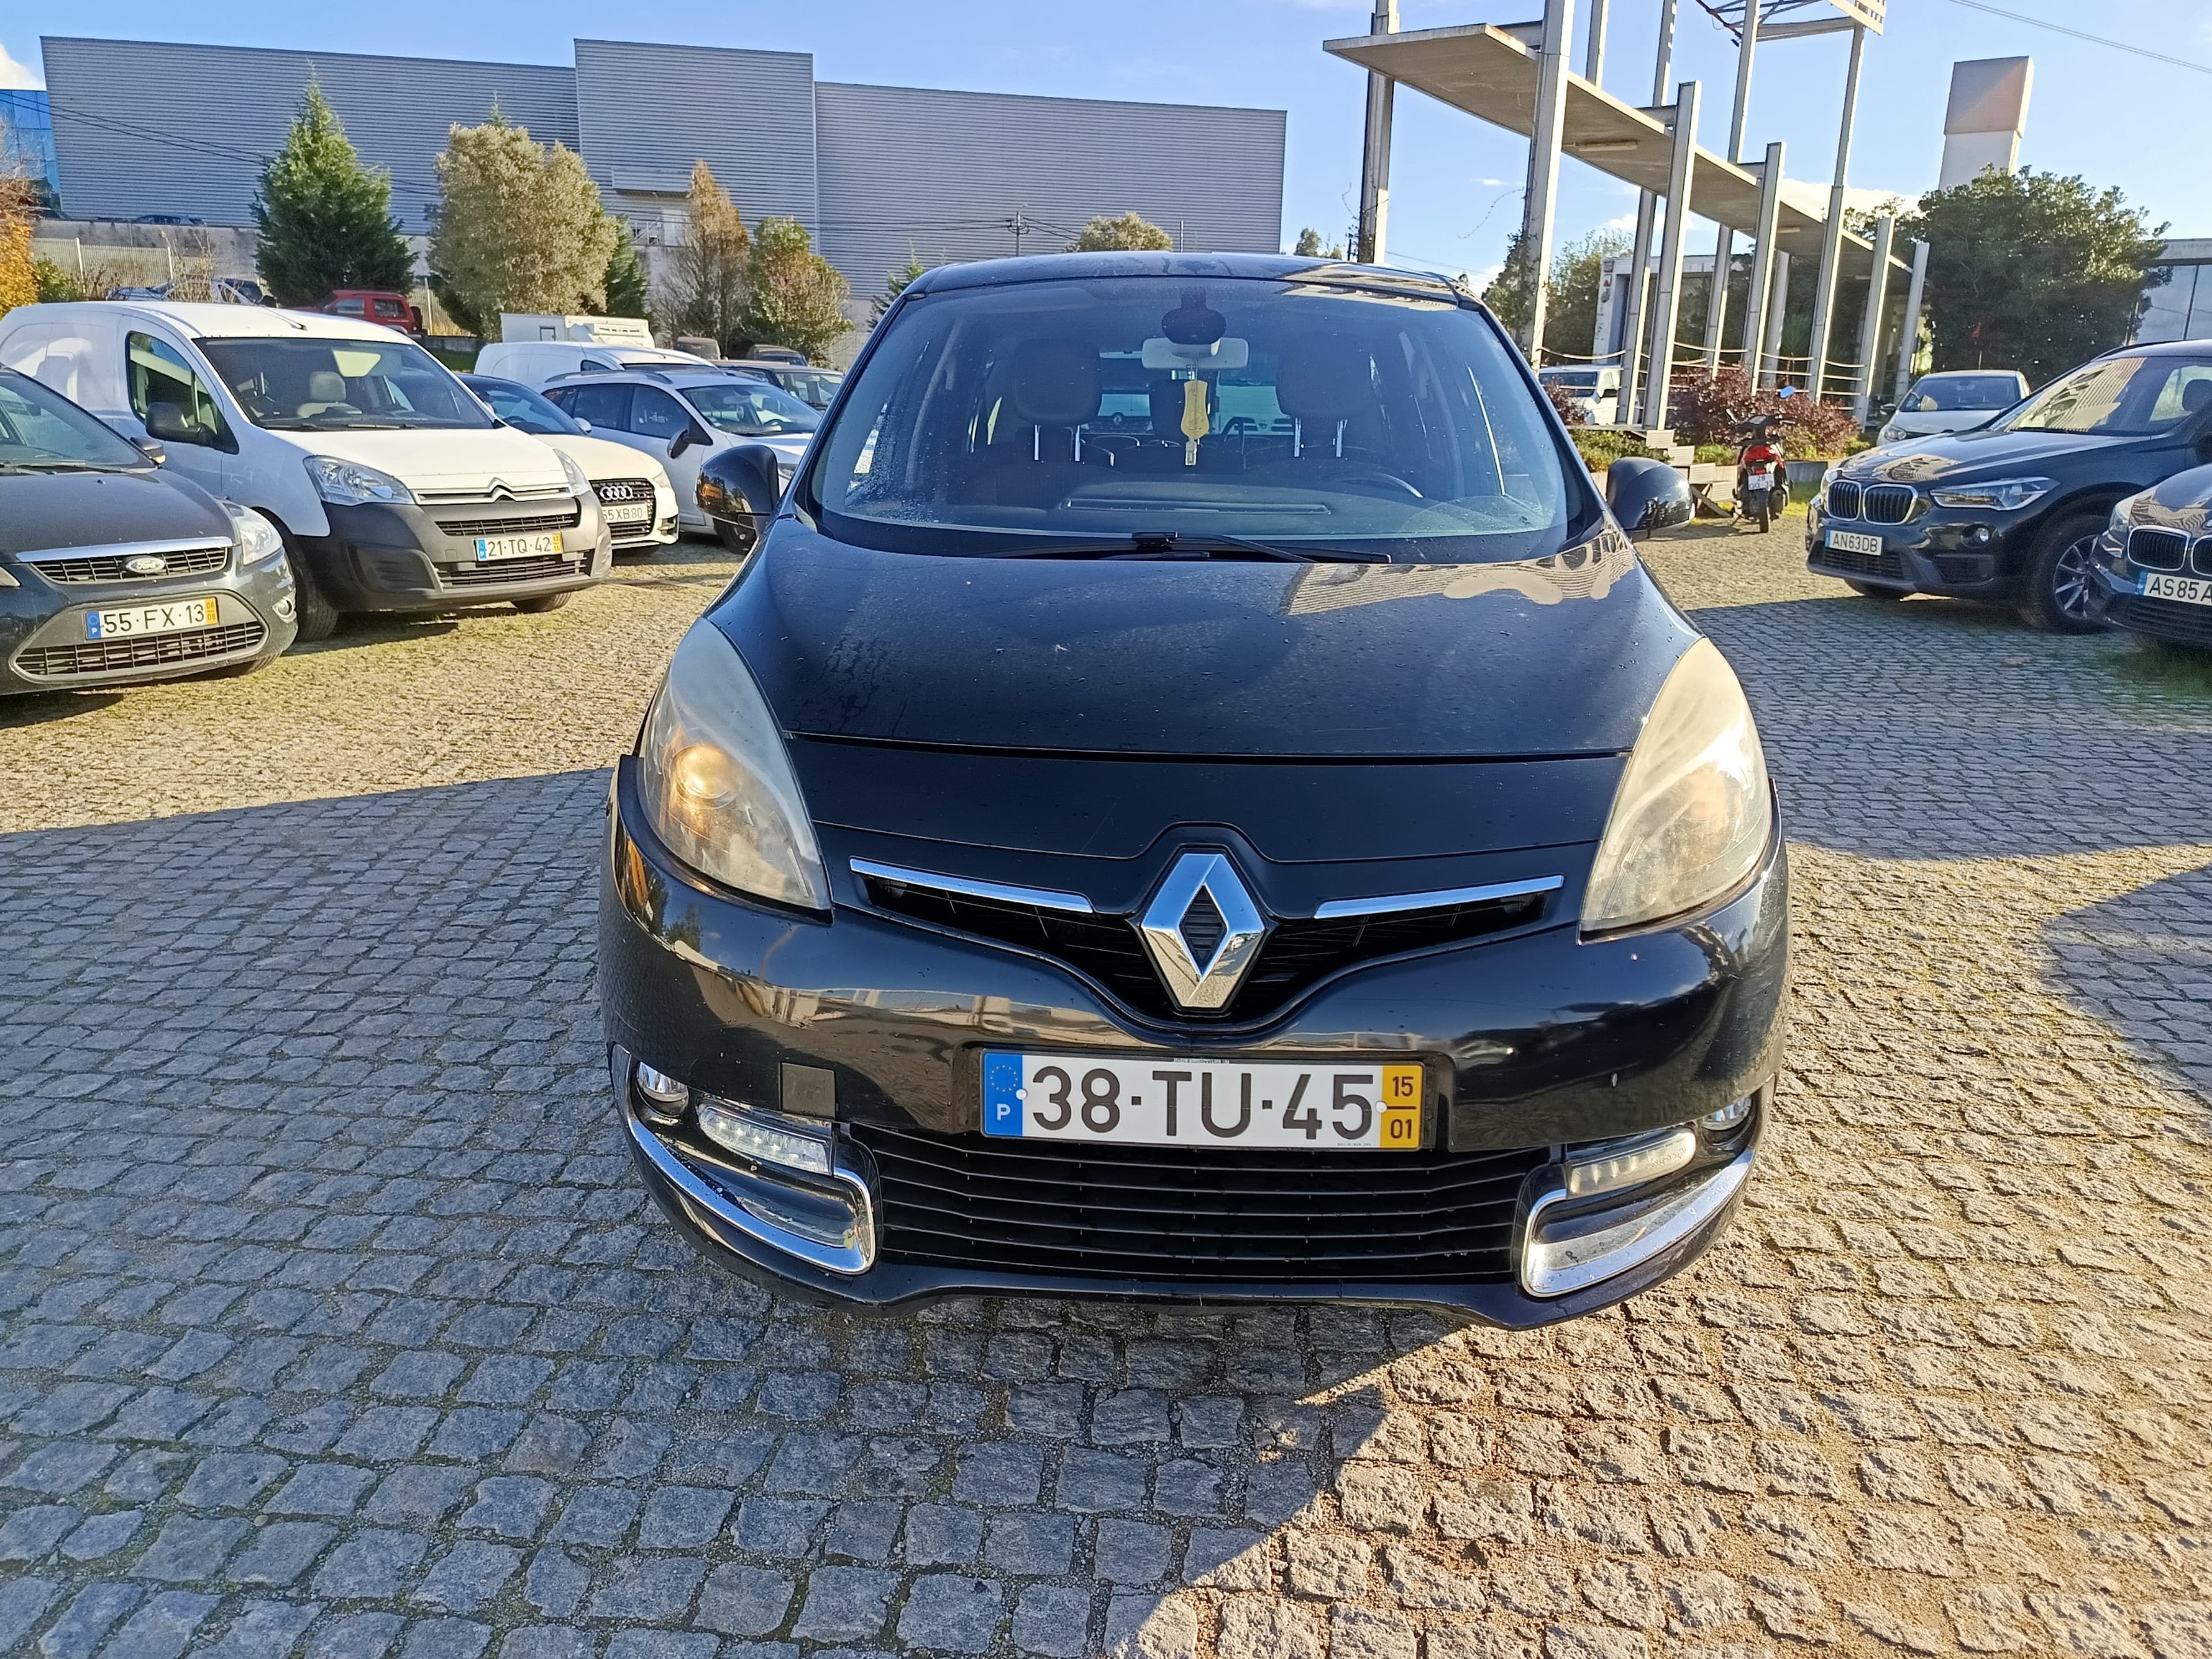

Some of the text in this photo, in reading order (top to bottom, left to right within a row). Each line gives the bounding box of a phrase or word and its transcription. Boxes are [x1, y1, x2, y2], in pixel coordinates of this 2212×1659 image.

[1833, 533, 1878, 552] AN63DB
[137, 560, 156, 569] Ford
[1392, 1076, 1414, 1097] 15
[997, 1103, 1011, 1121] P
[1390, 1119, 1412, 1139] 01
